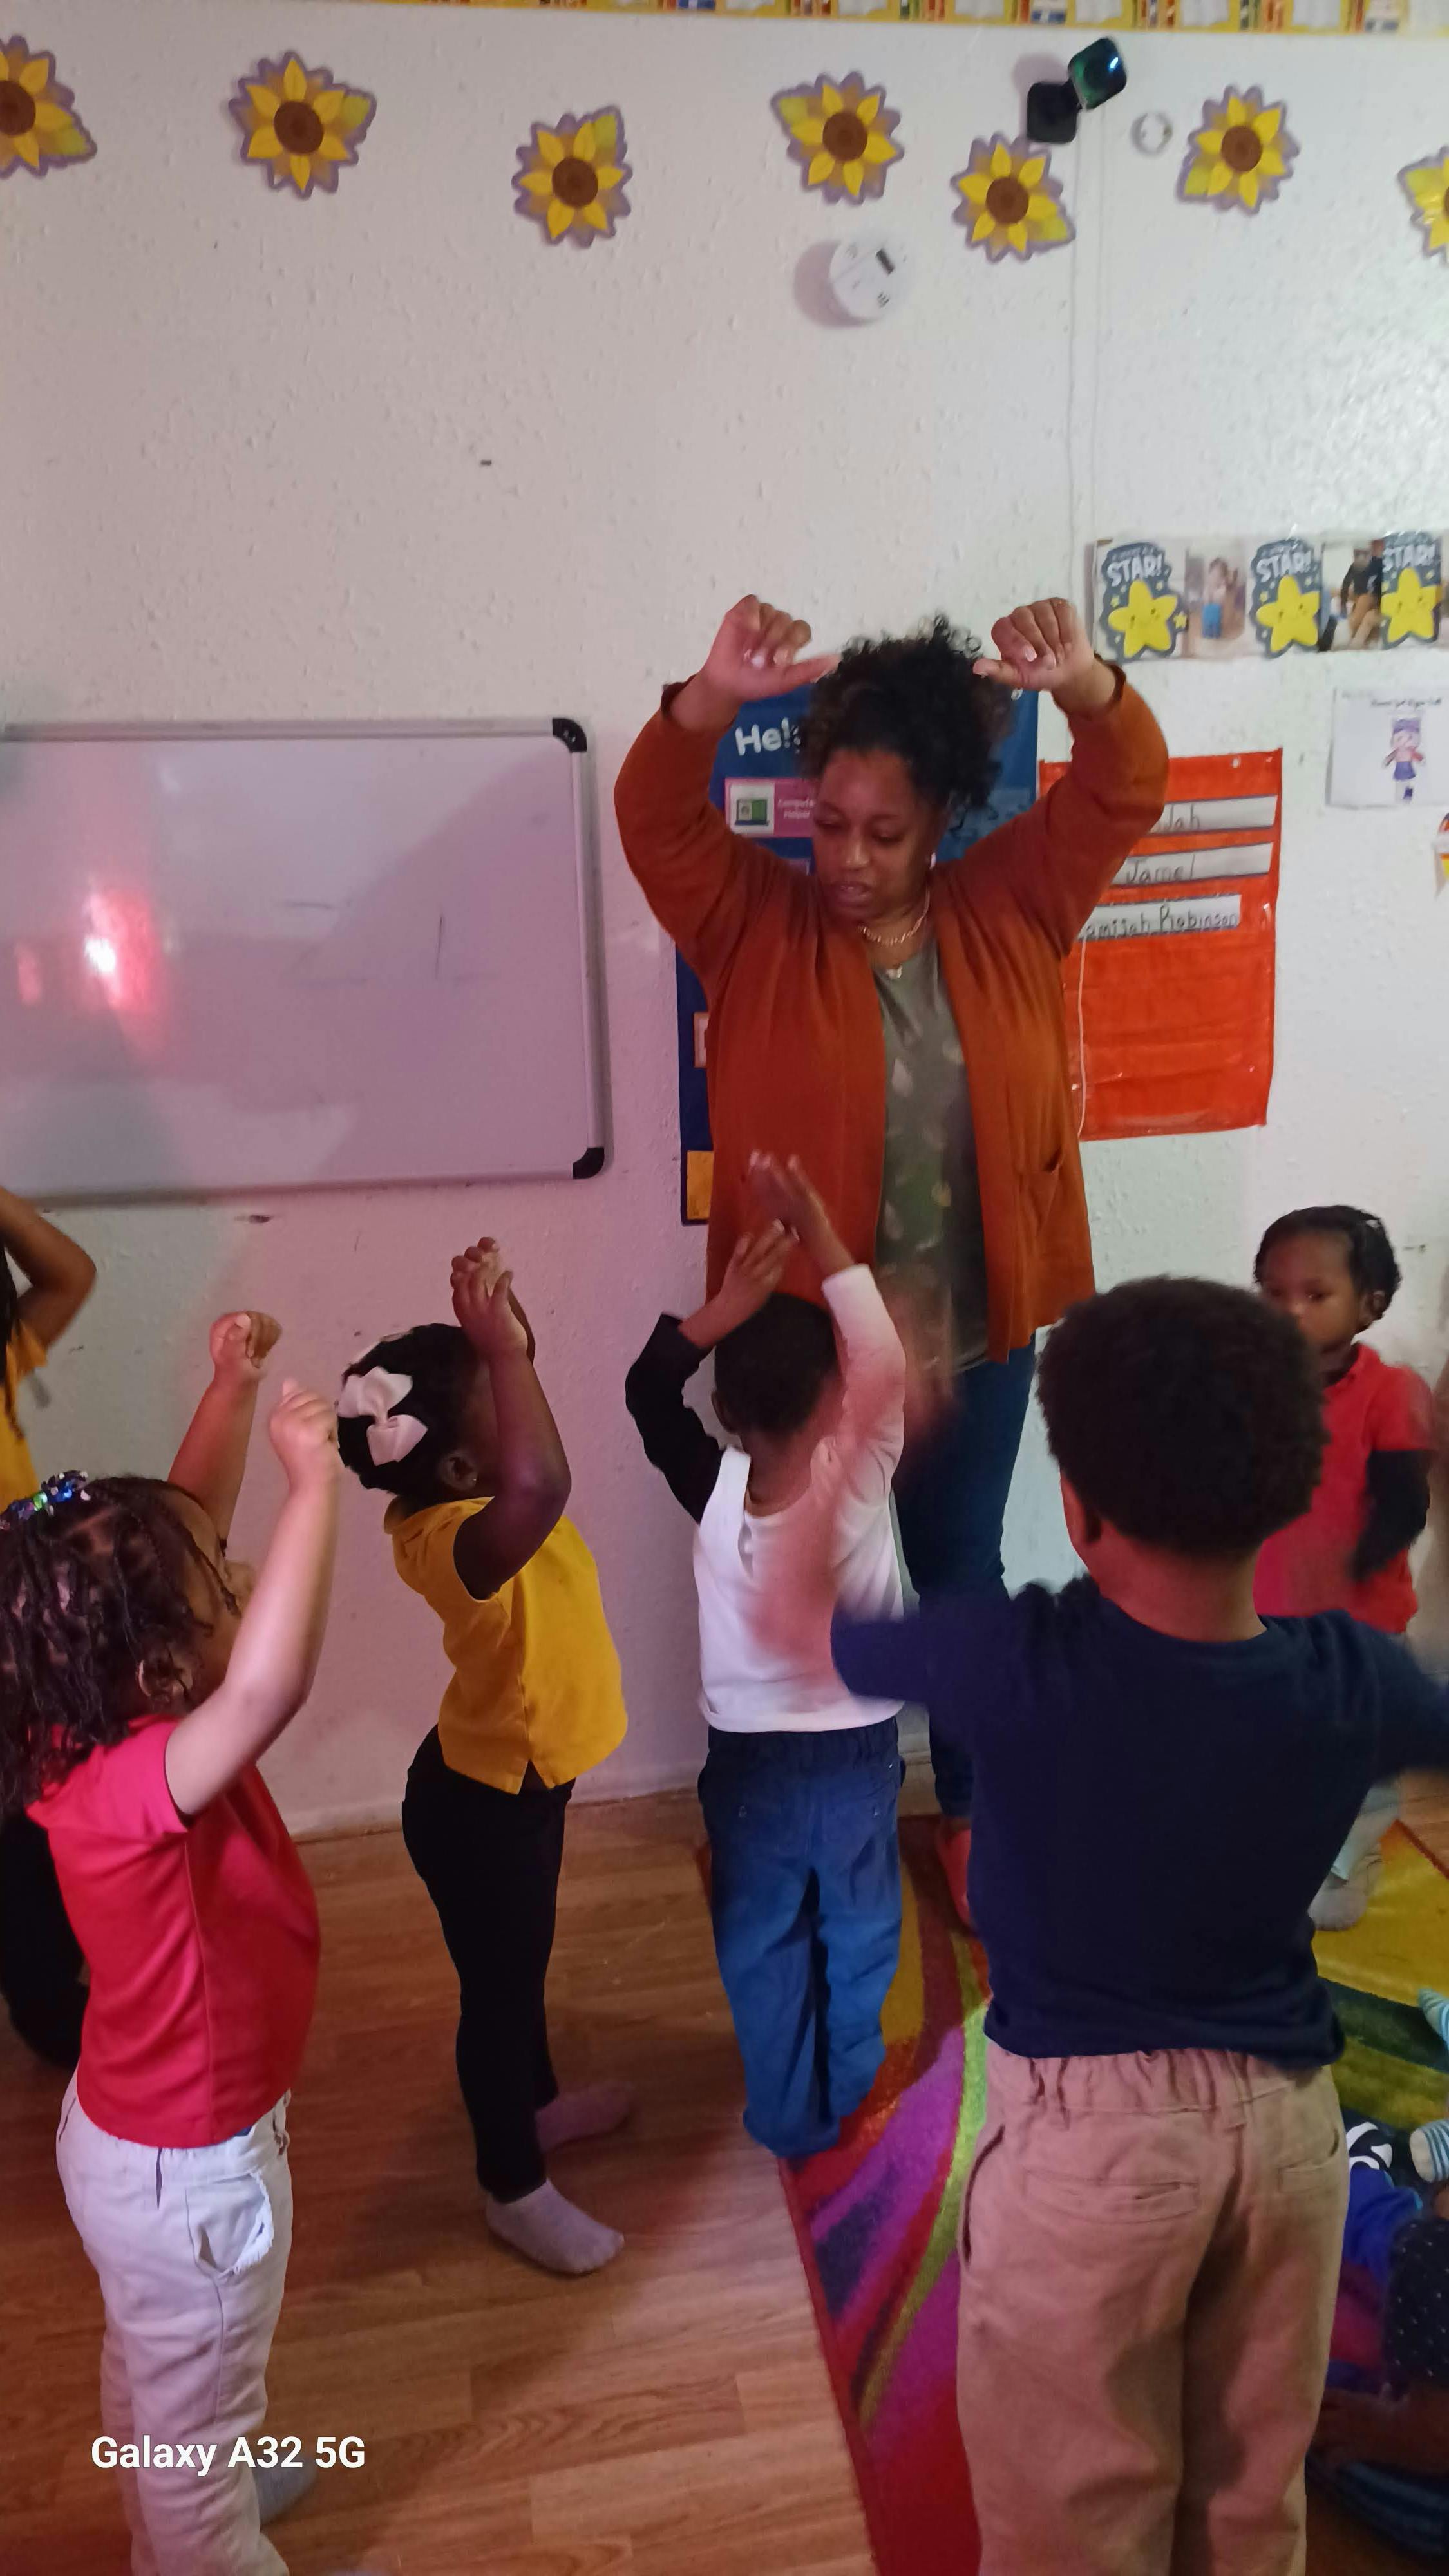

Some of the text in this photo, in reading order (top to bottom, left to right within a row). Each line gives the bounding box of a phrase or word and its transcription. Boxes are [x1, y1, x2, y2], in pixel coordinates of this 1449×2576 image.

[1107, 554, 1162, 587] STAR!
[1126, 855, 1195, 882] Jamel
[1160, 903, 1238, 931] Robinson
